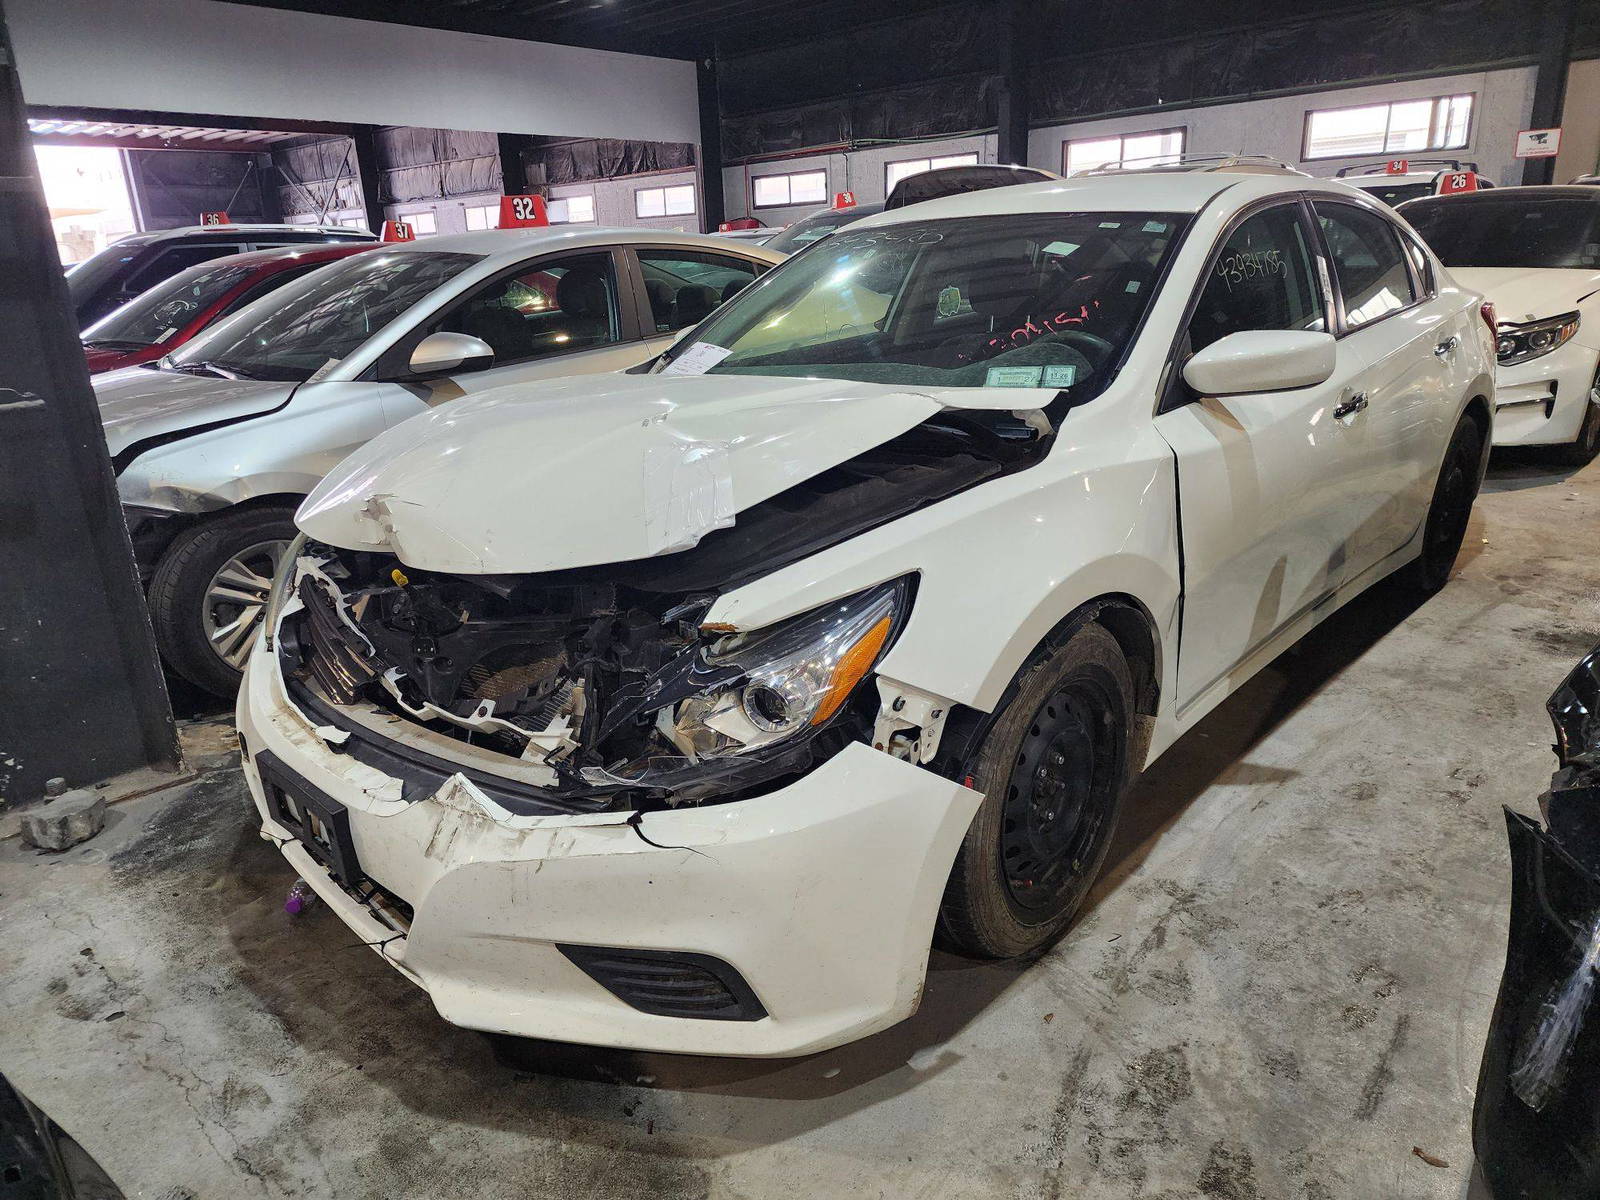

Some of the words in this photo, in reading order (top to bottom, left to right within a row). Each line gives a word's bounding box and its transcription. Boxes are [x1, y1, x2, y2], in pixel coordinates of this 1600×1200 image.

[1451, 174, 1466, 189] 26
[512, 197, 536, 220] 32
[206, 213, 219, 225] 36
[395, 222, 409, 239] 37
